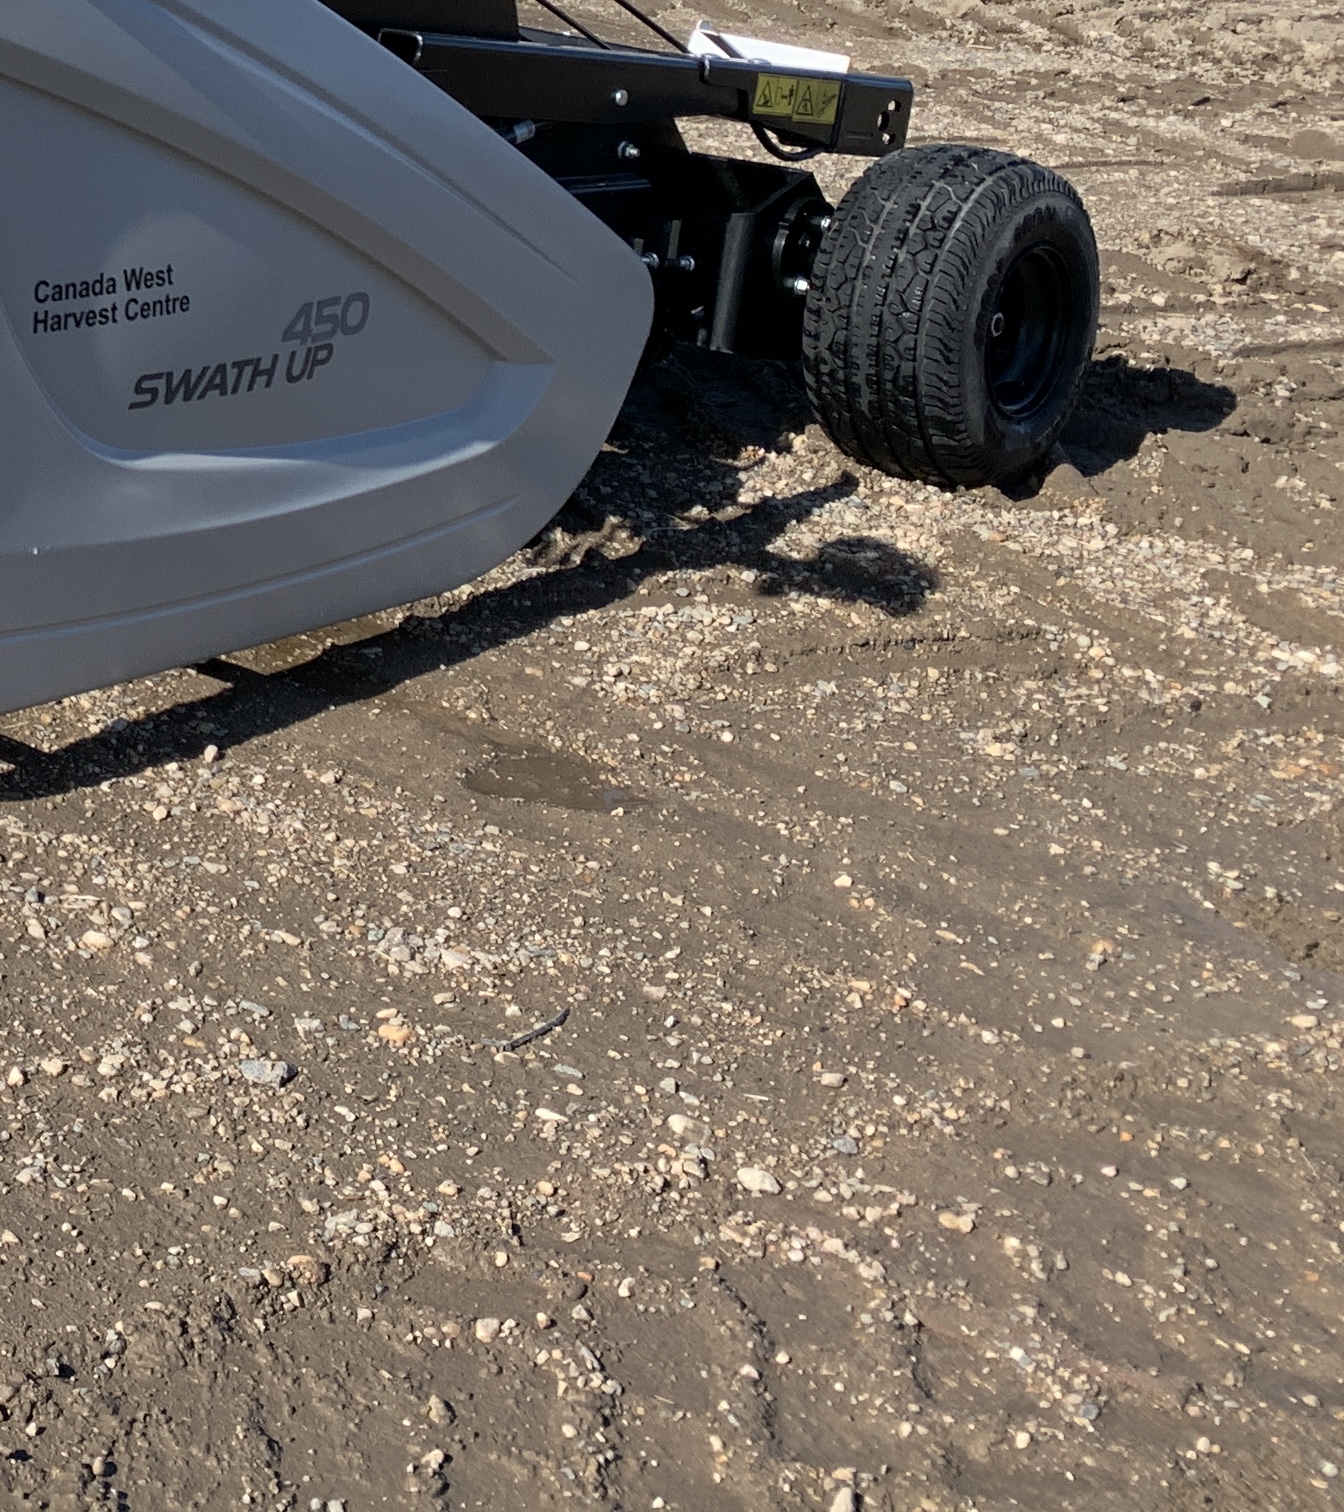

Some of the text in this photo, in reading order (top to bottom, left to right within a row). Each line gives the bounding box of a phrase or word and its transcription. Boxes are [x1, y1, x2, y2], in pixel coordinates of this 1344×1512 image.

[34, 263, 174, 304] Canada West
[32, 294, 191, 334] Harvest Centre
[281, 291, 371, 346] 450
[128, 342, 334, 411] SWATH UP
